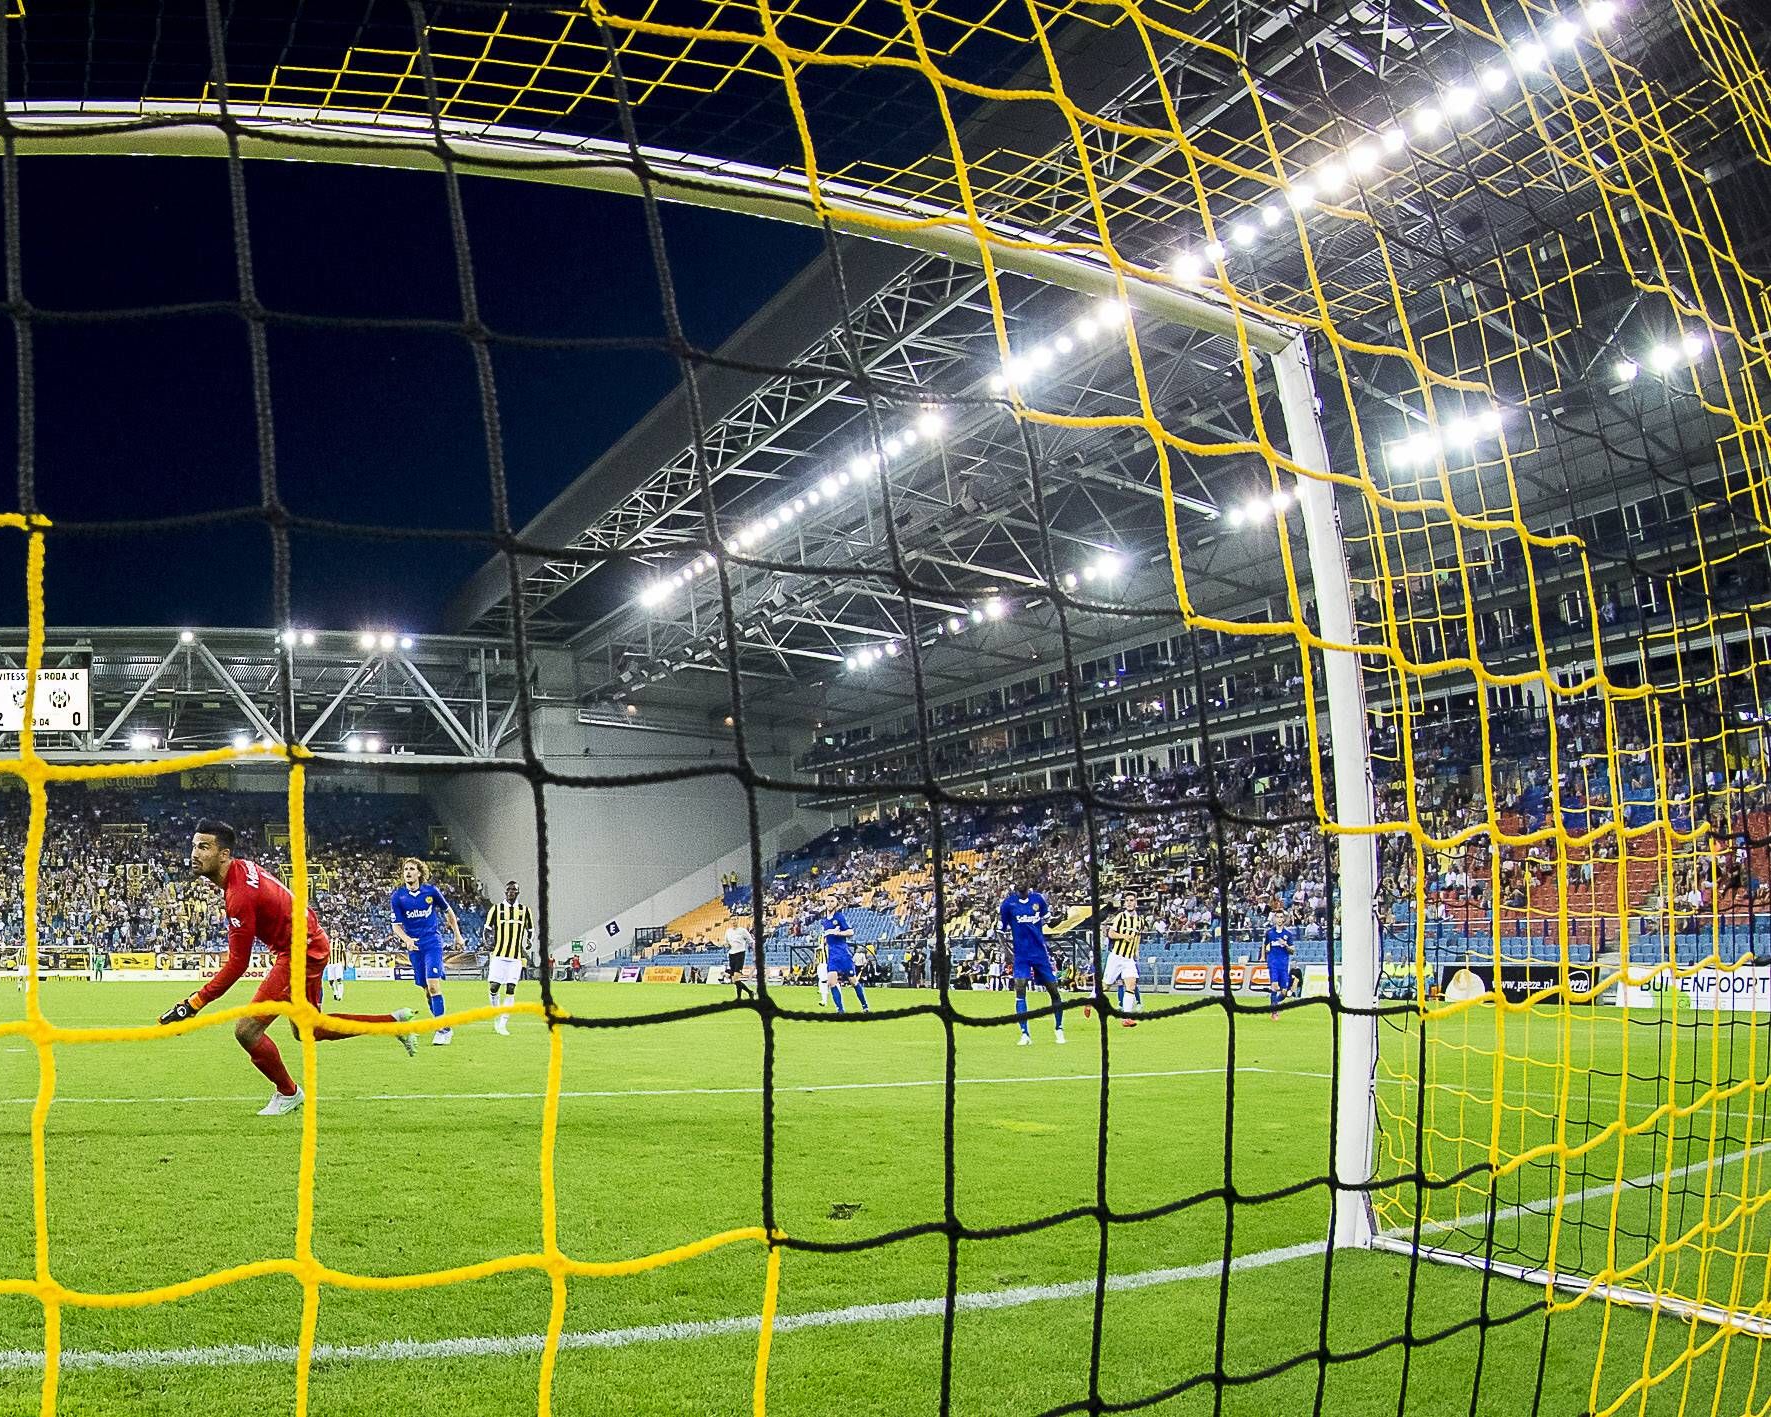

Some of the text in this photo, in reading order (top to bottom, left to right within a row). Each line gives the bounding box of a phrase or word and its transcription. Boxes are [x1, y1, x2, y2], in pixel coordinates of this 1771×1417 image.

[44, 672, 67, 681] RODA
[69, 672, 80, 681] JC
[72, 711, 81, 726] 0
[1640, 976, 1770, 994] BUIENPOORT
